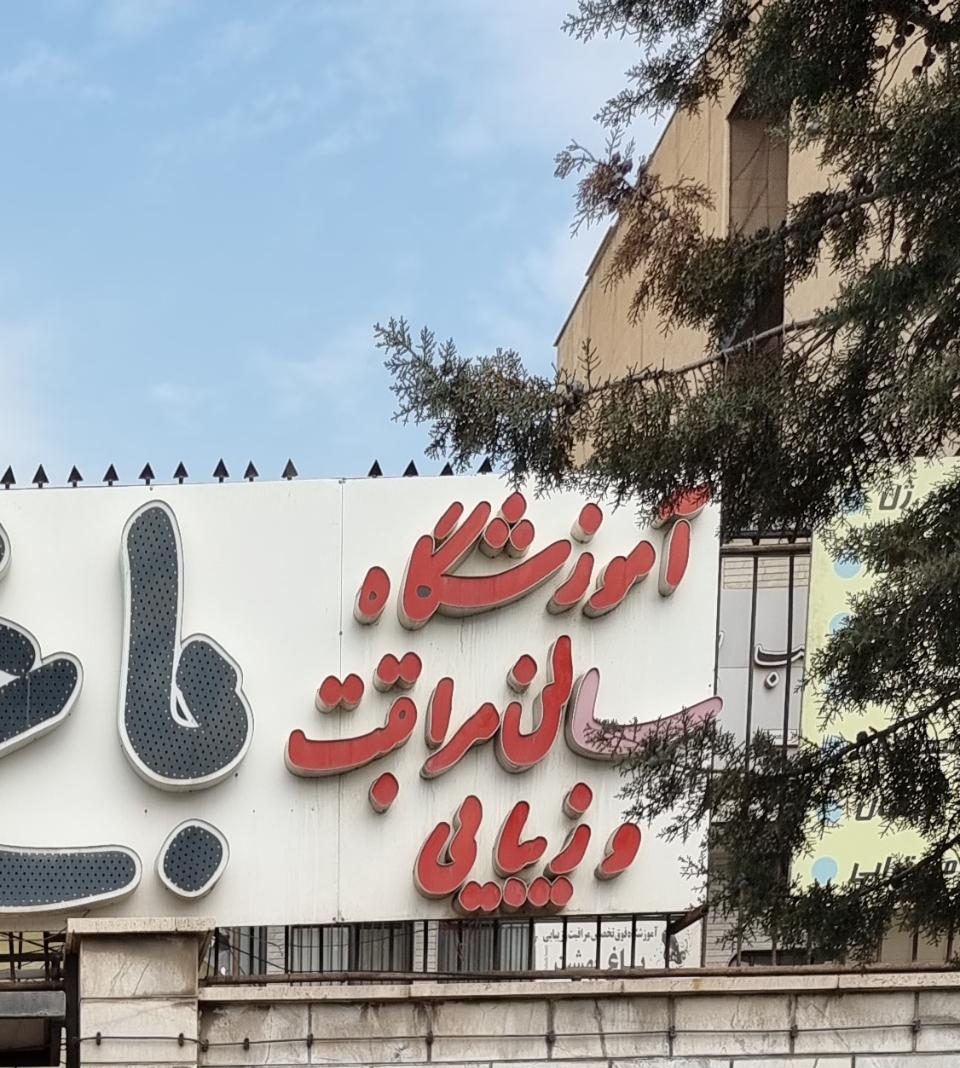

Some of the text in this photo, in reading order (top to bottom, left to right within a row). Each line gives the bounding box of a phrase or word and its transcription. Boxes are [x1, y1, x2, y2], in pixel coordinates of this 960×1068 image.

[354, 483, 714, 631] آموزشگاه
[284, 635, 725, 813] سالن مراقبت
[413, 782, 642, 913] و زیبایی
